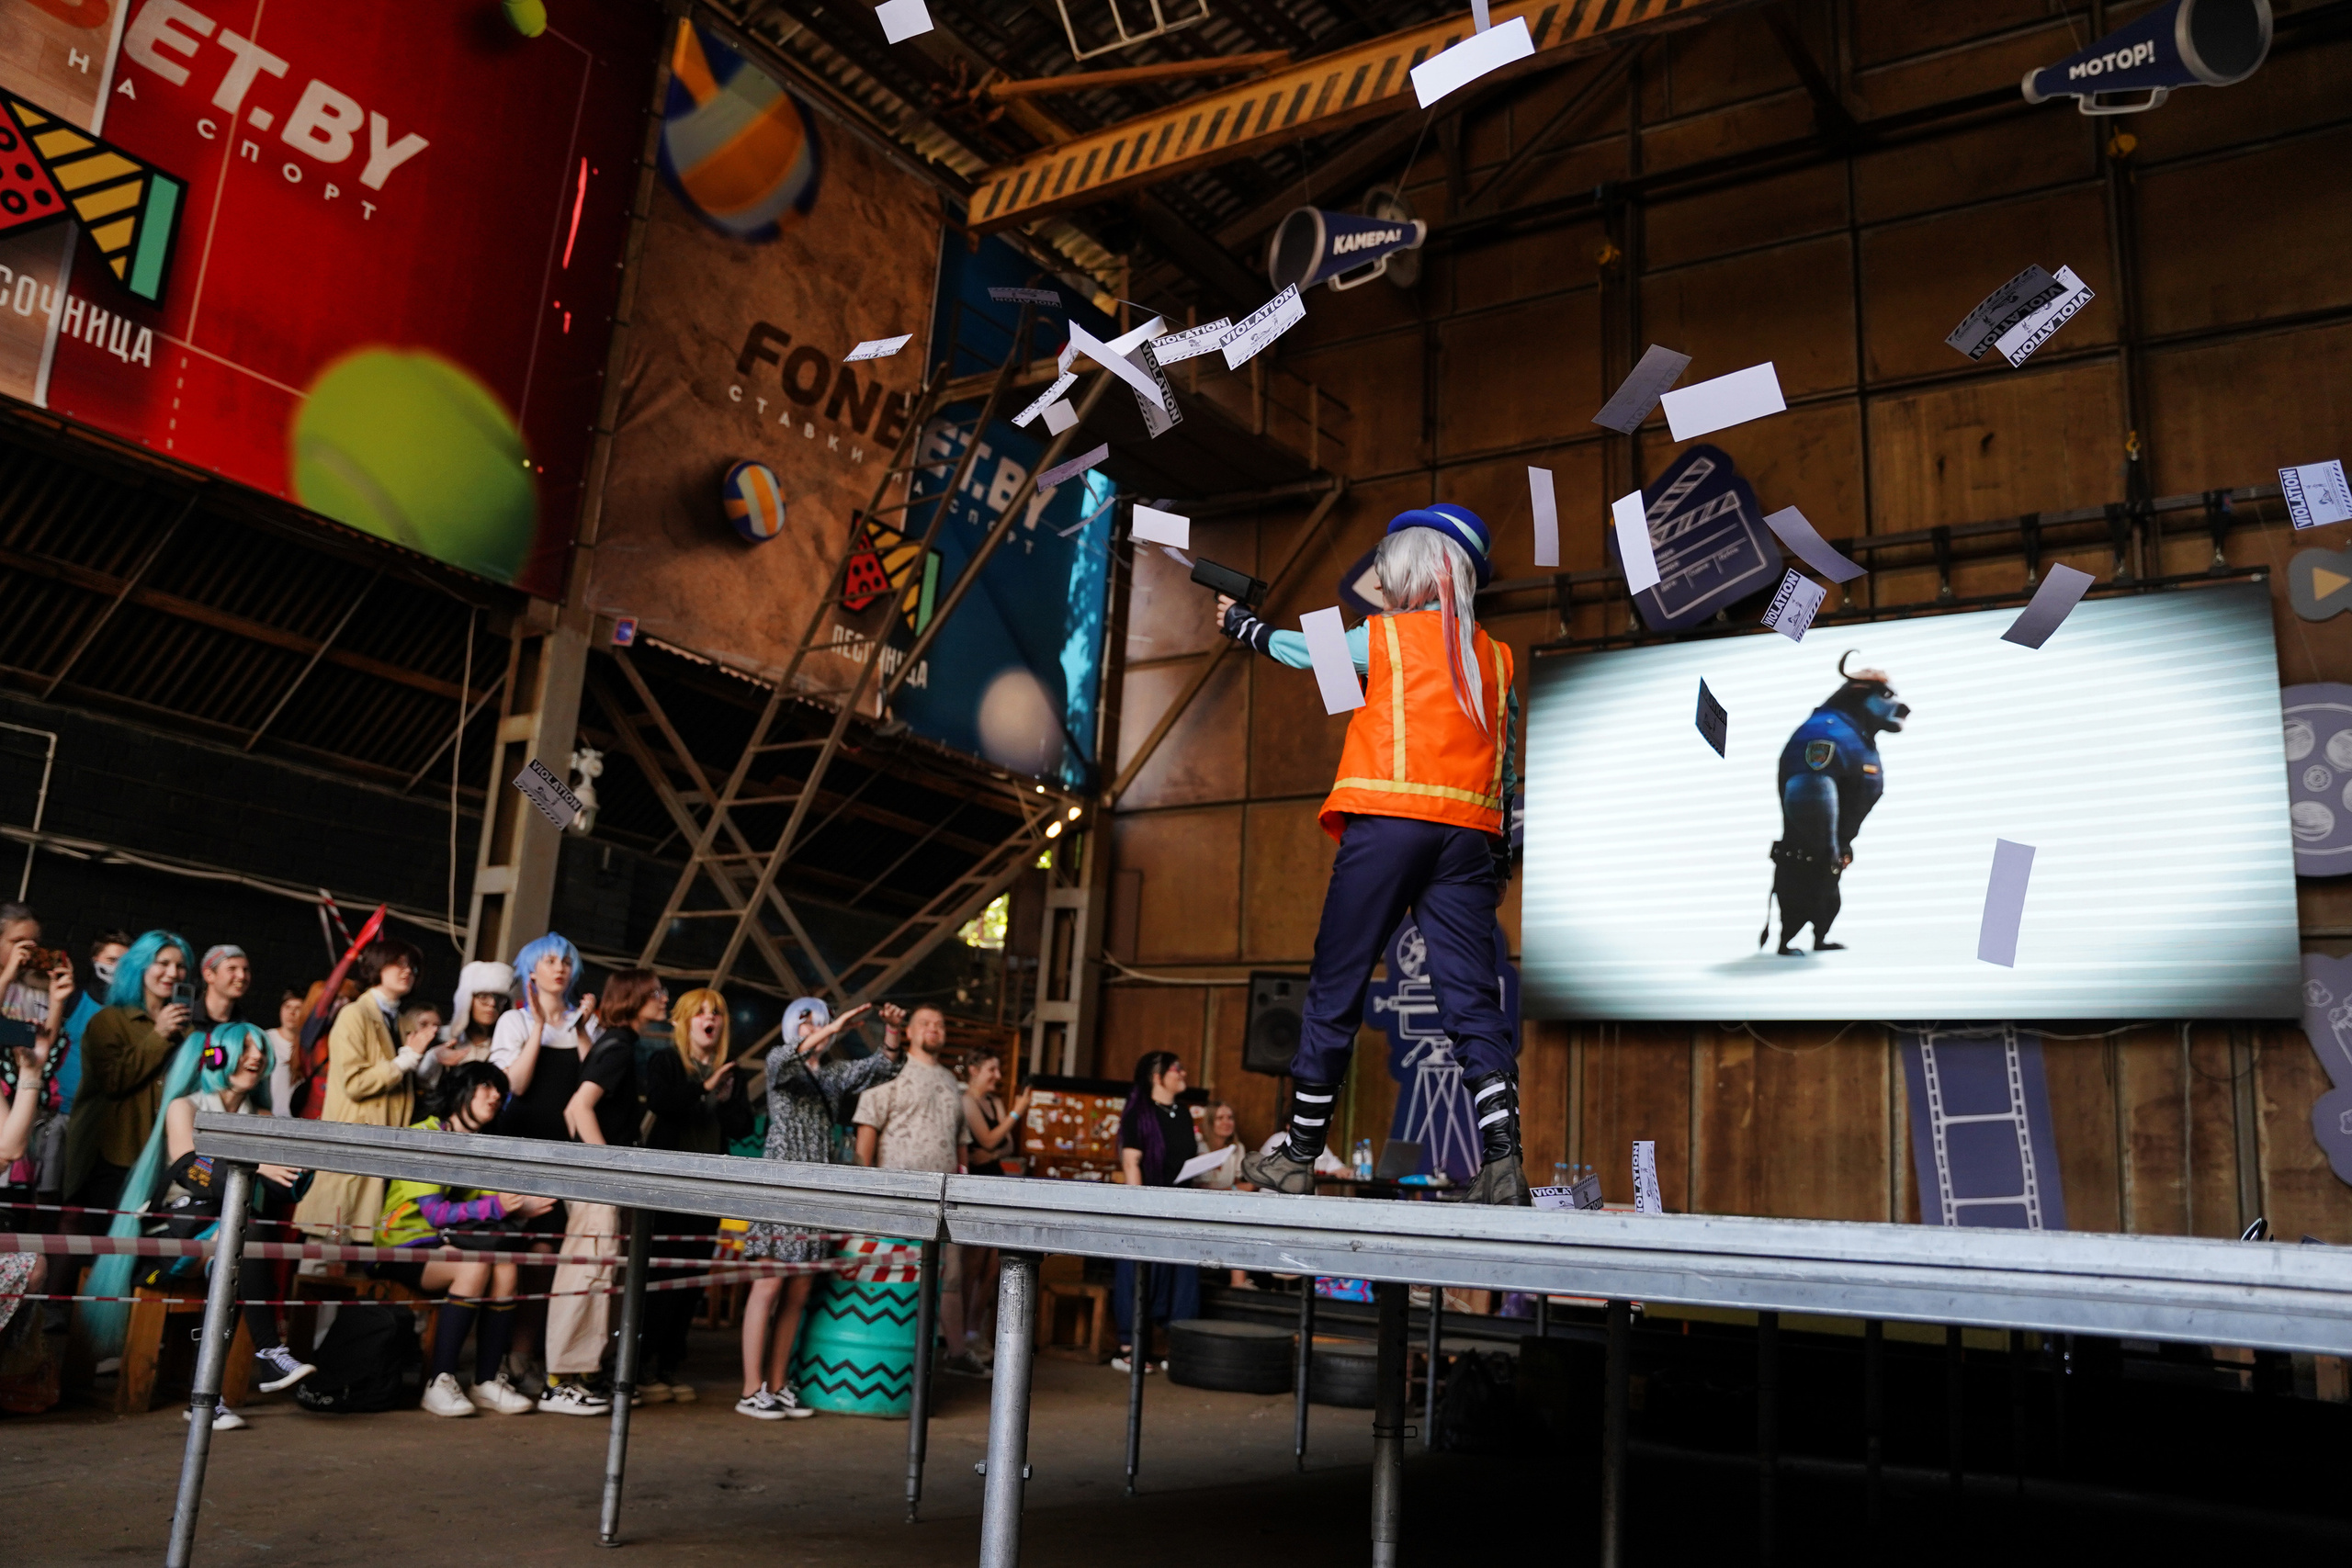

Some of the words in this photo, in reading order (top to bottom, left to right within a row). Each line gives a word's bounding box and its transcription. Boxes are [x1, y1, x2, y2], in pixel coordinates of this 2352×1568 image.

[2069, 39, 2155, 81] МОТОР!
[42, 0, 430, 191] ET.BY
[67, 47, 137, 100] НА
[196, 118, 377, 220] СПОРТ
[1333, 228, 1402, 255] КАМЕРА!
[1152, 320, 1227, 347] VIOLATION
[1221, 287, 1295, 344] VIOLATION
[1973, 286, 2063, 358] VIOLATION
[2012, 291, 2091, 364] VIOLATION
[1014, 373, 1066, 420] VIOLATION
[1142, 342, 1180, 422] VIOLATION
[729, 384, 863, 464] СТАВКИ
[2281, 469, 2312, 527] VIOLATION
[1764, 572, 1799, 626] VIOLATION
[533, 761, 581, 809] VIOLATION
